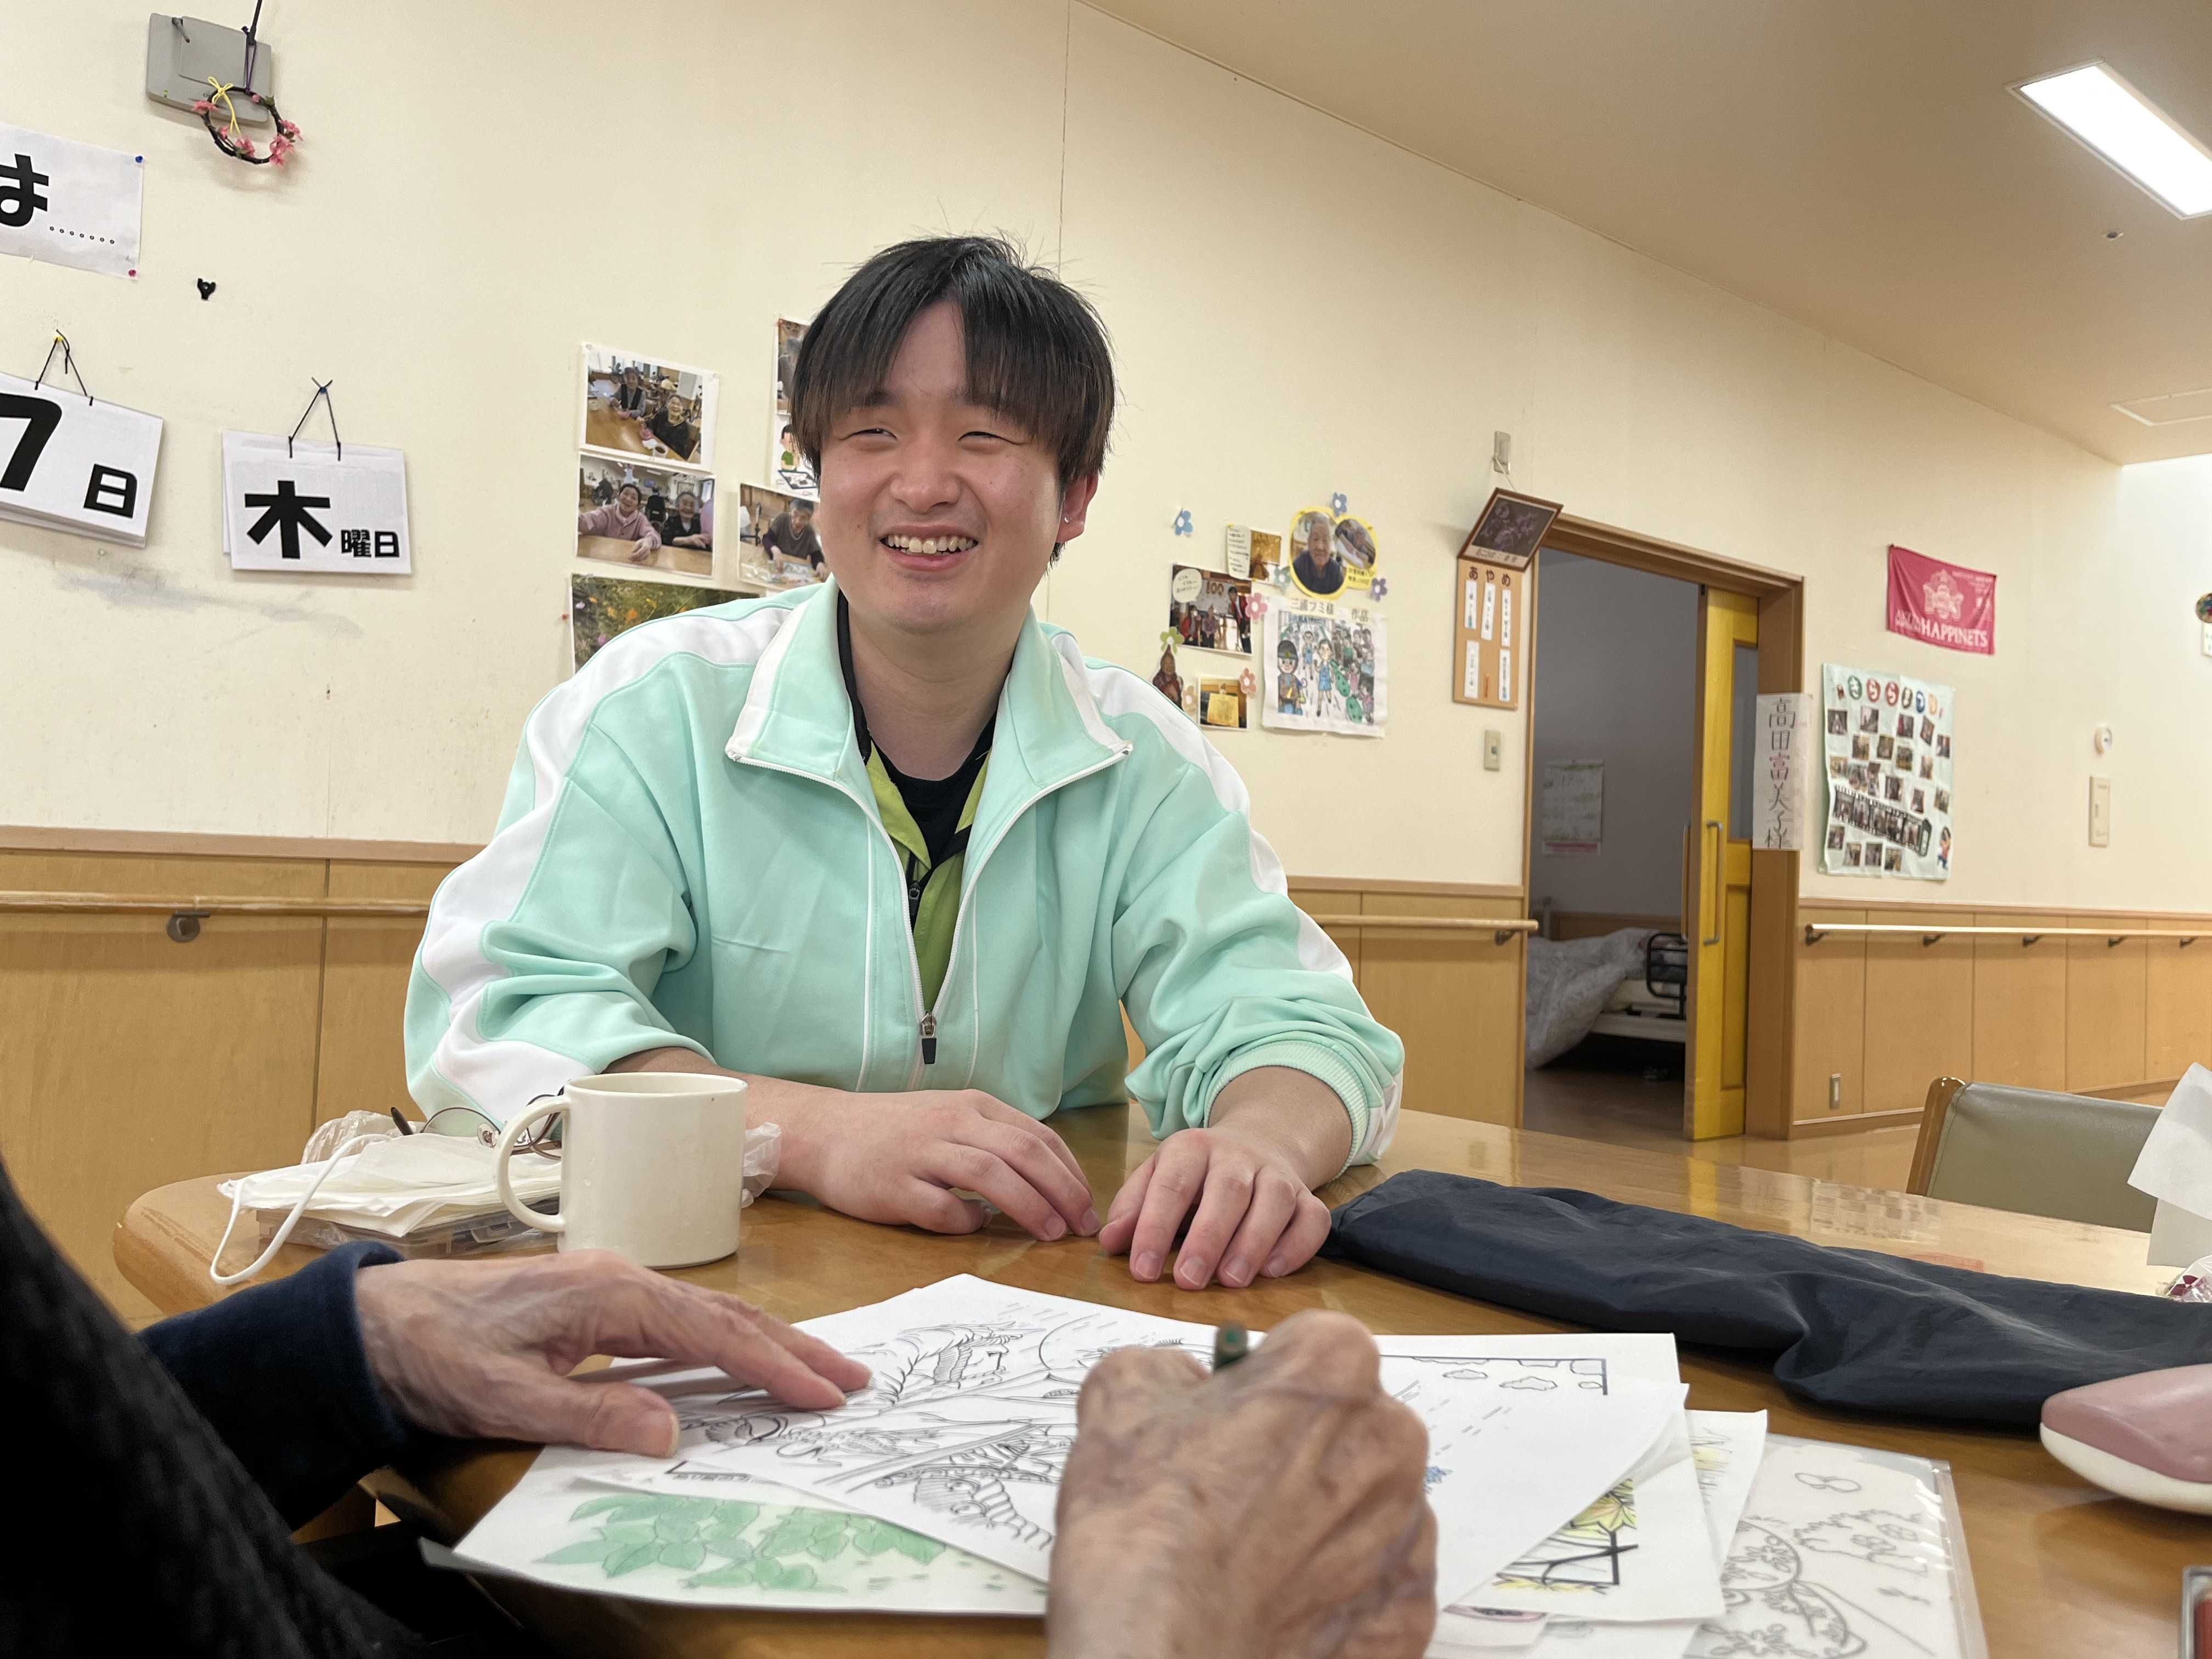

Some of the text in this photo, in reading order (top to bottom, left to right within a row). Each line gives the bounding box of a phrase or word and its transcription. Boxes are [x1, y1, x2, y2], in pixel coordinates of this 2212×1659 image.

[245, 480, 400, 560] 木曜日
[1921, 616, 1989, 648] HAPPINETS
